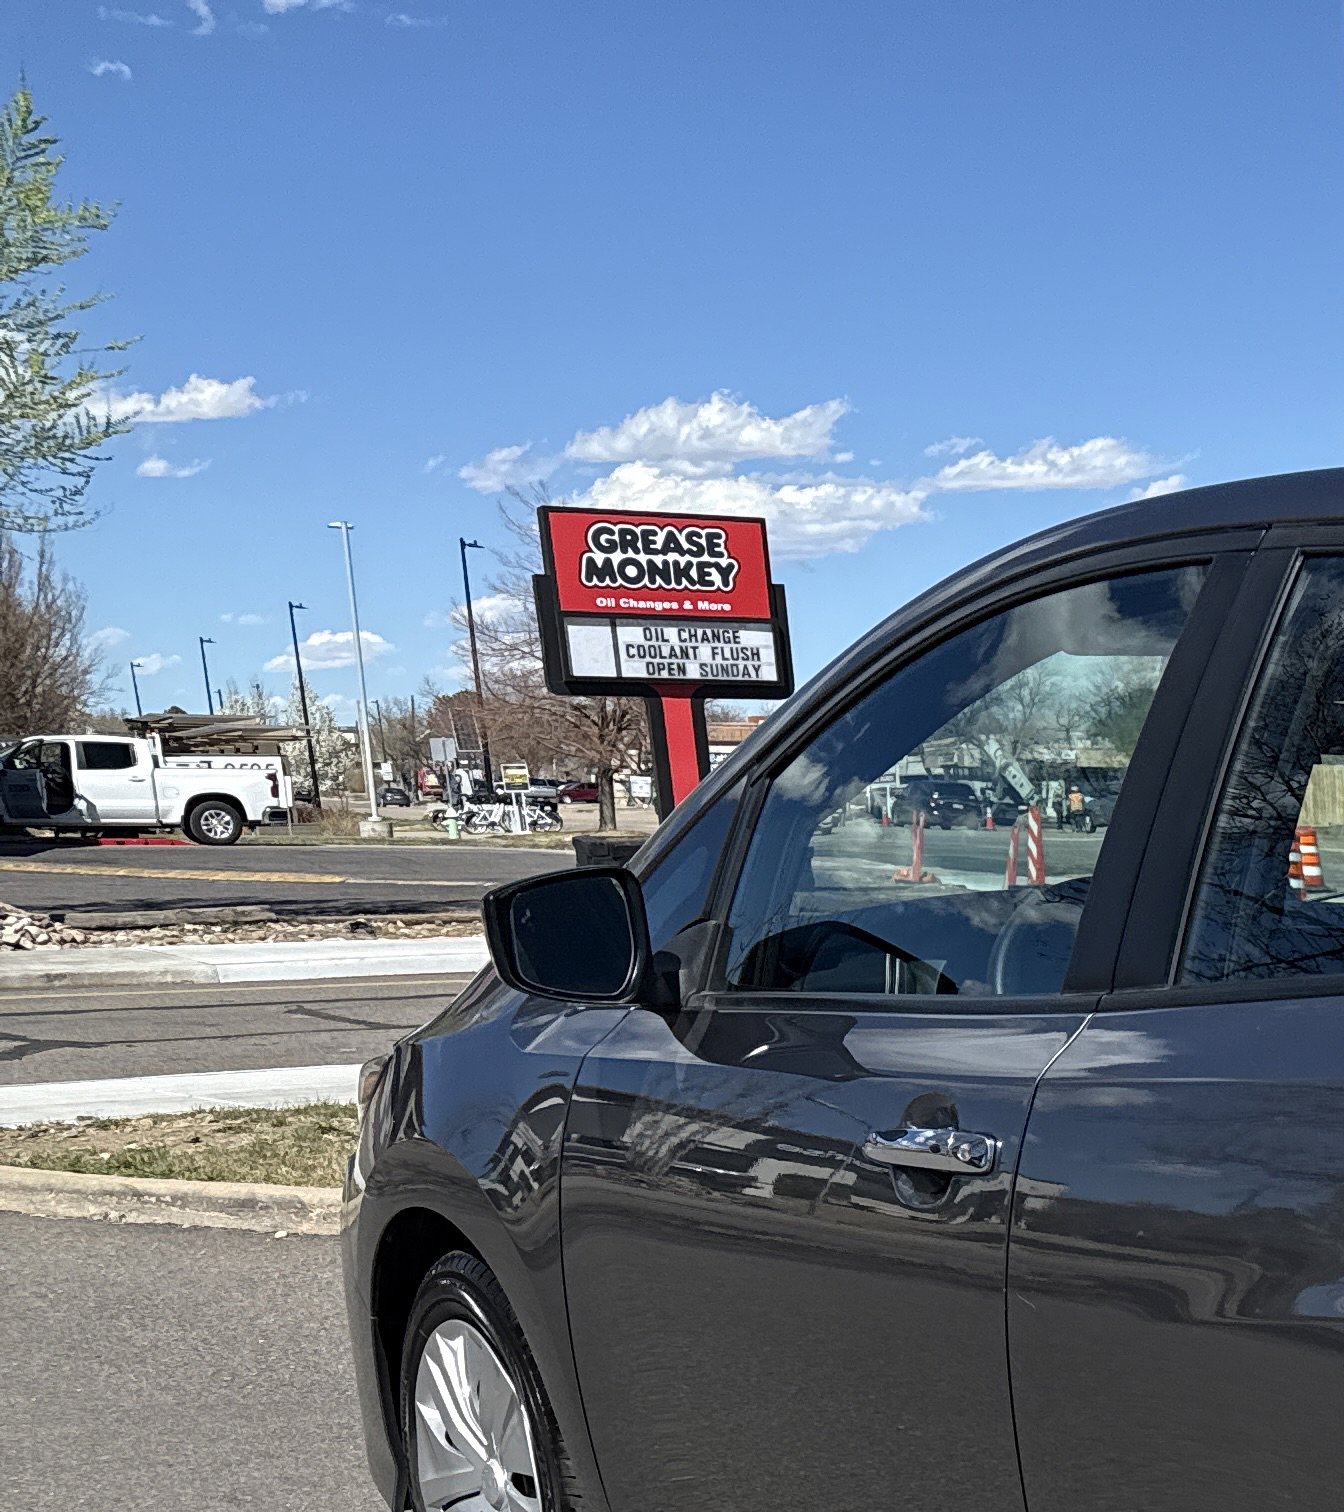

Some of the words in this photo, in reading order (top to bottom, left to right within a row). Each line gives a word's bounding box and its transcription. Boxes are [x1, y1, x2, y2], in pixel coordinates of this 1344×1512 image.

[591, 525, 725, 559] GREASE
[584, 556, 736, 588] MONKEY
[596, 597, 616, 608] Oil
[619, 598, 679, 611] Changes
[683, 600, 693, 610] &
[697, 600, 732, 611] More
[642, 627, 670, 643] OIL
[677, 629, 741, 644] CHANGE
[625, 643, 699, 661] COOLANT
[711, 646, 761, 662] FLUSH
[646, 662, 687, 677] OPEN
[700, 663, 761, 679] SUNDAY
